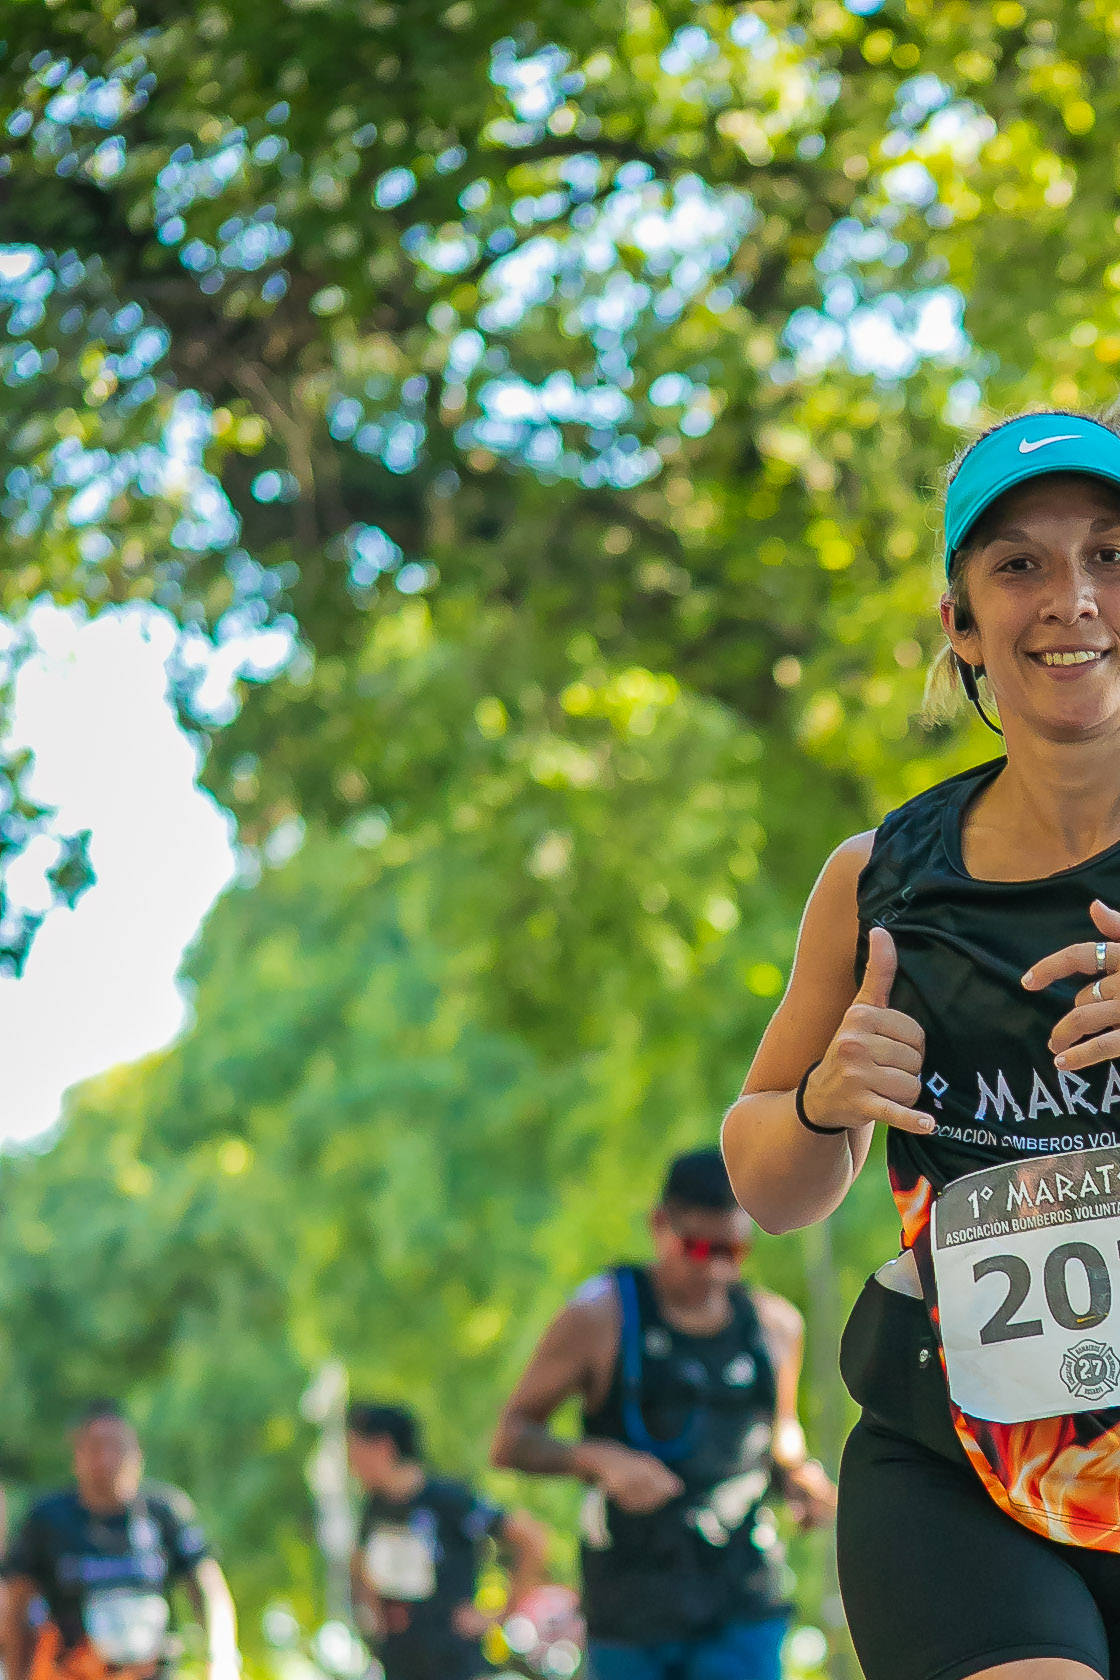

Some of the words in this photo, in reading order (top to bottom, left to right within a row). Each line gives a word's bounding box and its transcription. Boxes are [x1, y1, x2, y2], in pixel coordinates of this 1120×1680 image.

[945, 1219, 1010, 1246] ASOCIACIÓN
[1011, 1207, 1074, 1233] BOMBEROS
[1078, 1358, 1104, 1381] 27
